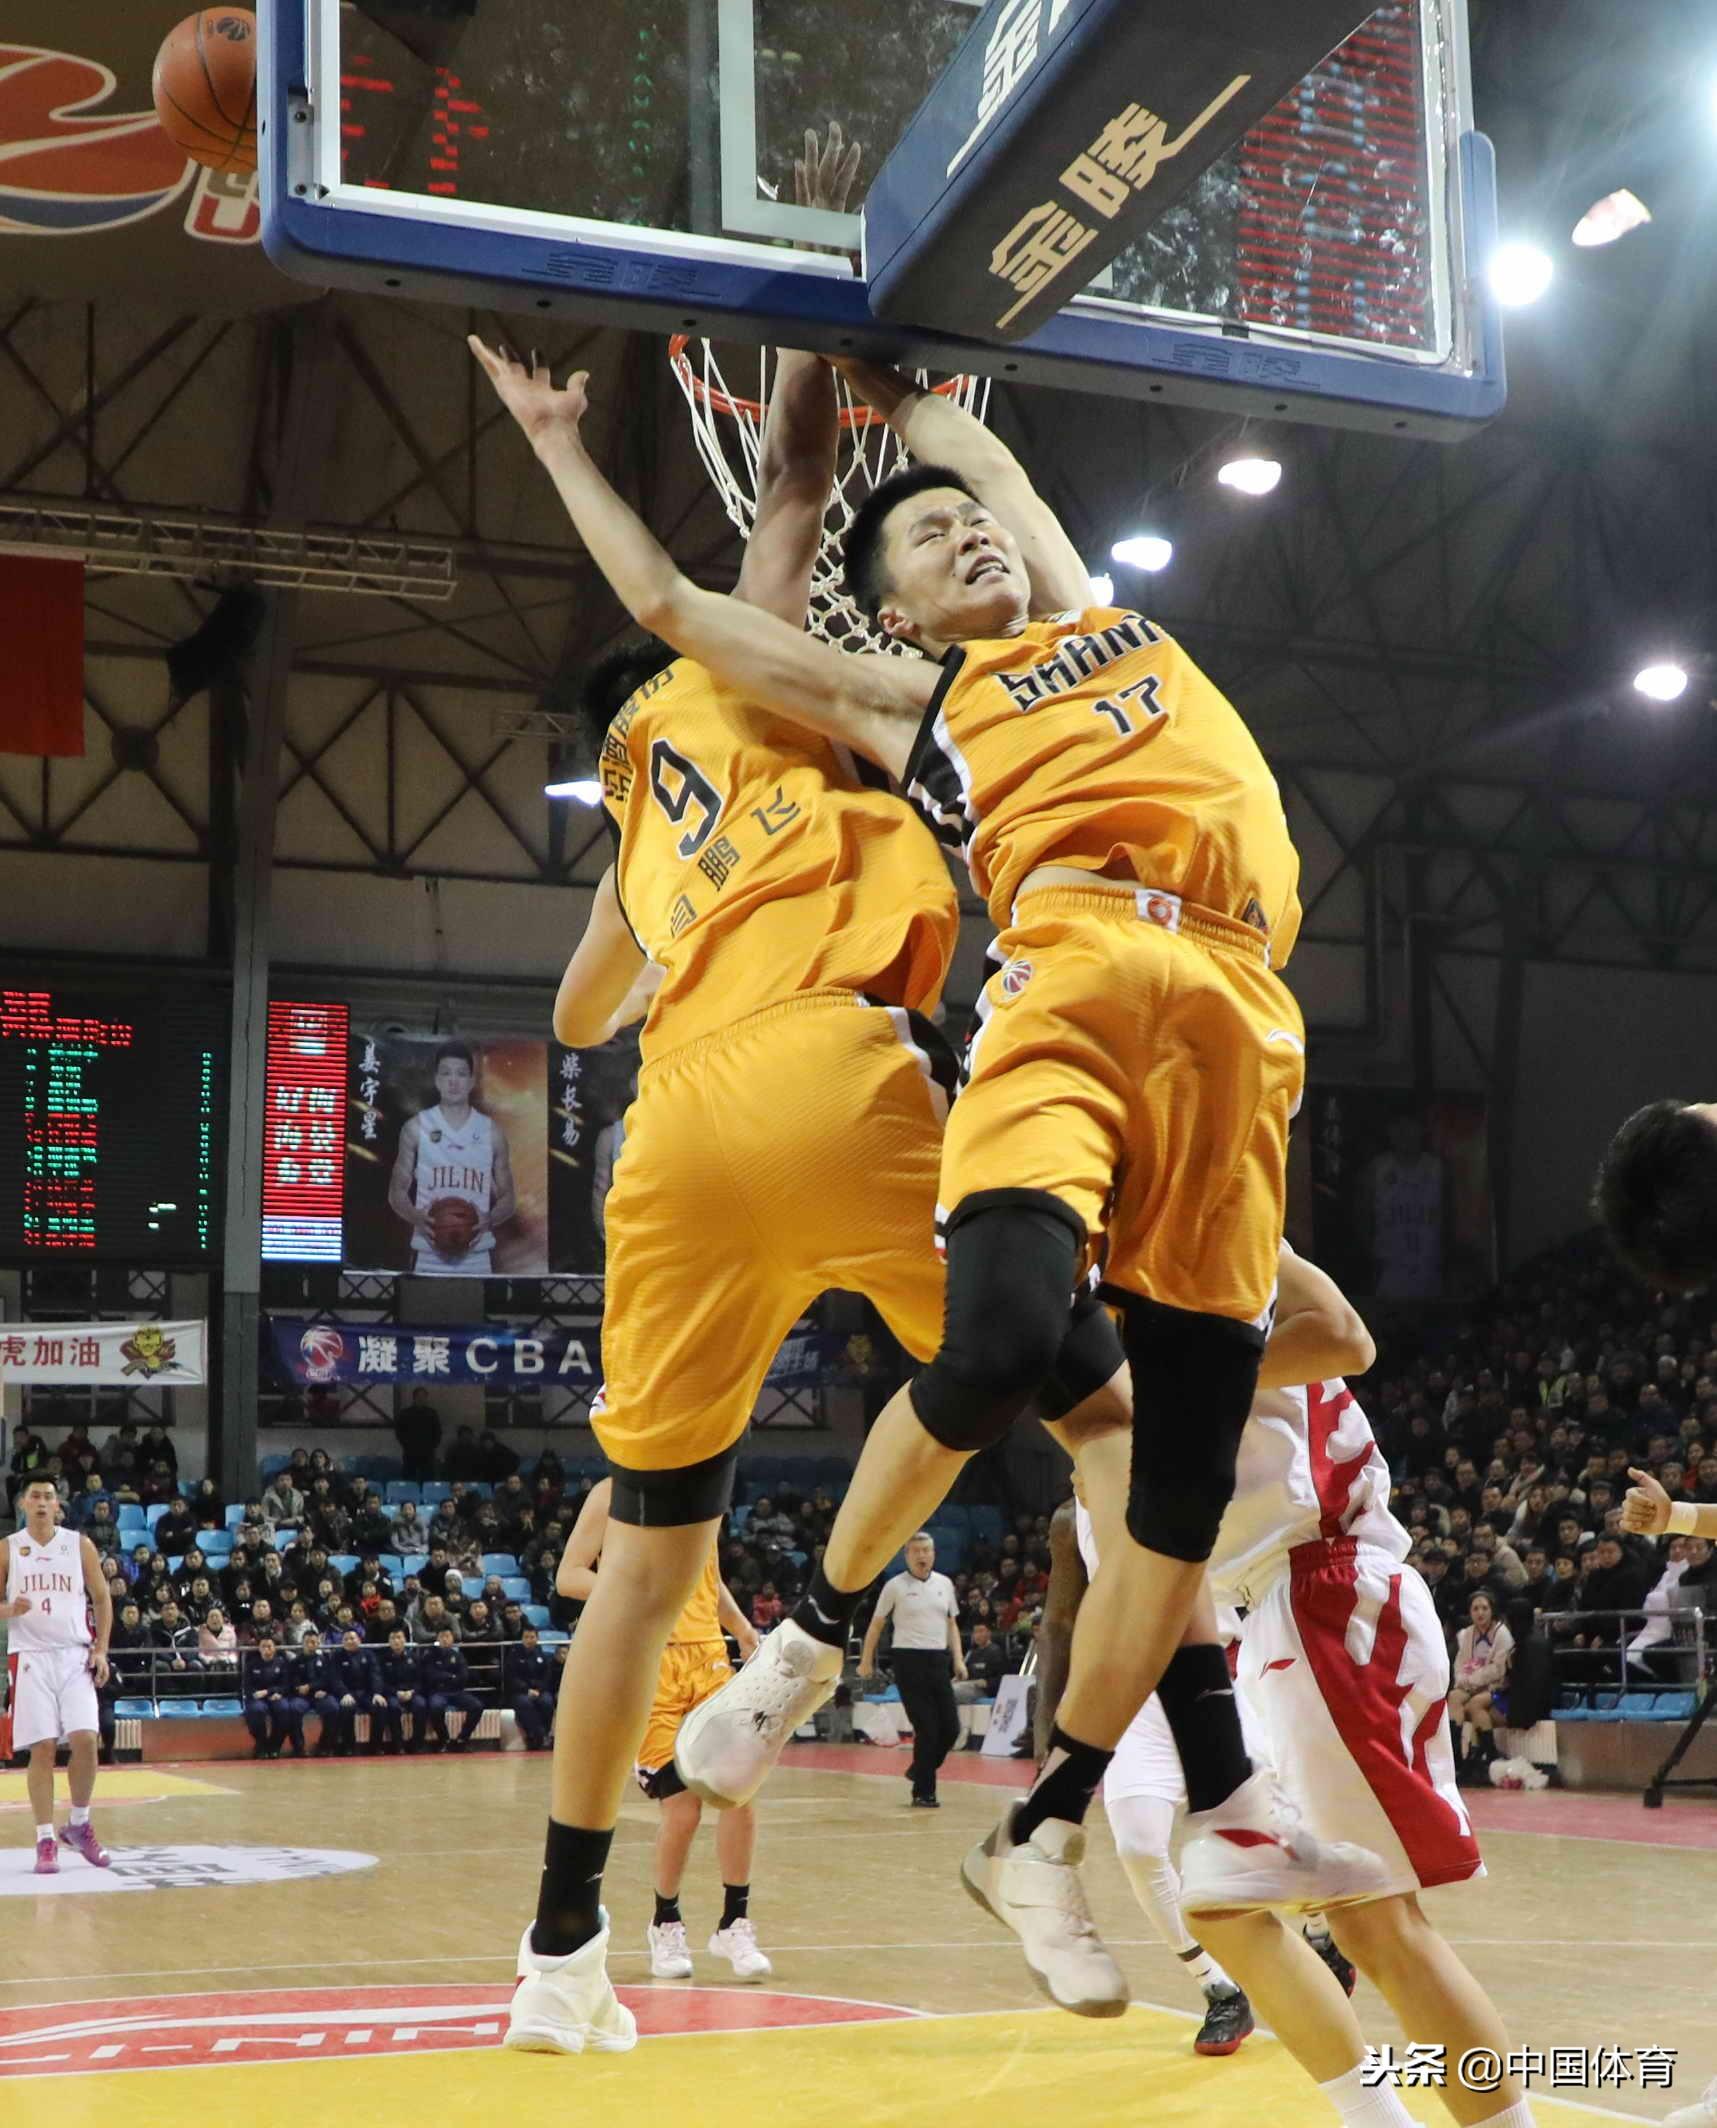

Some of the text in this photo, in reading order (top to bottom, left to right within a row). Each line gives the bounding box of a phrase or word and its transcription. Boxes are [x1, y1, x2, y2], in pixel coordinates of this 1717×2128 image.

[988, 75, 1251, 329] 金陵
[1094, 674, 1166, 736] 17
[650, 737, 724, 861] 9
[427, 1166, 485, 1194] JILIN
[0, 1335, 101, 1368] 虎加油
[20, 1573, 72, 1594] JILIN
[41, 1597, 52, 1616] 4
